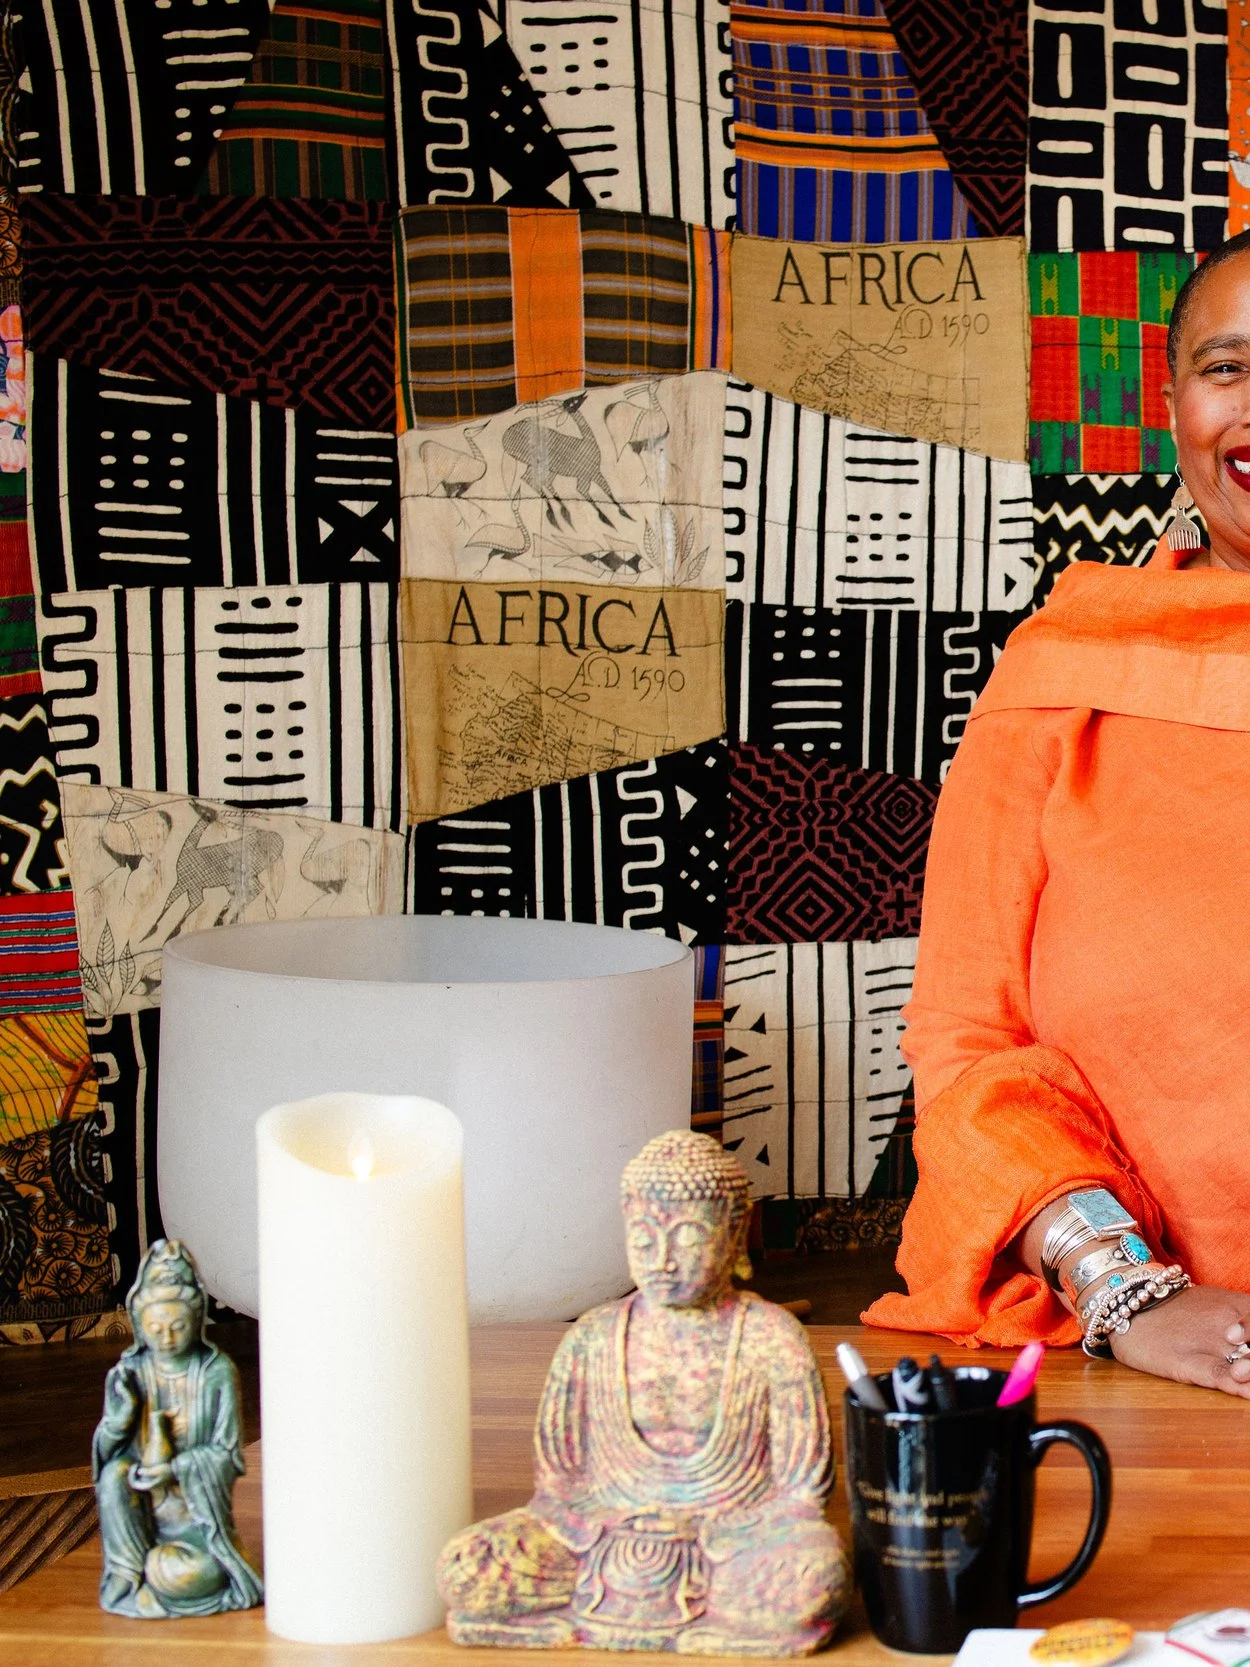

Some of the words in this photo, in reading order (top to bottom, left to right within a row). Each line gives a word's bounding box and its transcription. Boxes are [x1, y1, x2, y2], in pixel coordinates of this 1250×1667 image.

[771, 247, 987, 311] AFRICA
[942, 312, 990, 348] 1590
[445, 587, 683, 657] AFRICA
[631, 666, 685, 702] 1590
